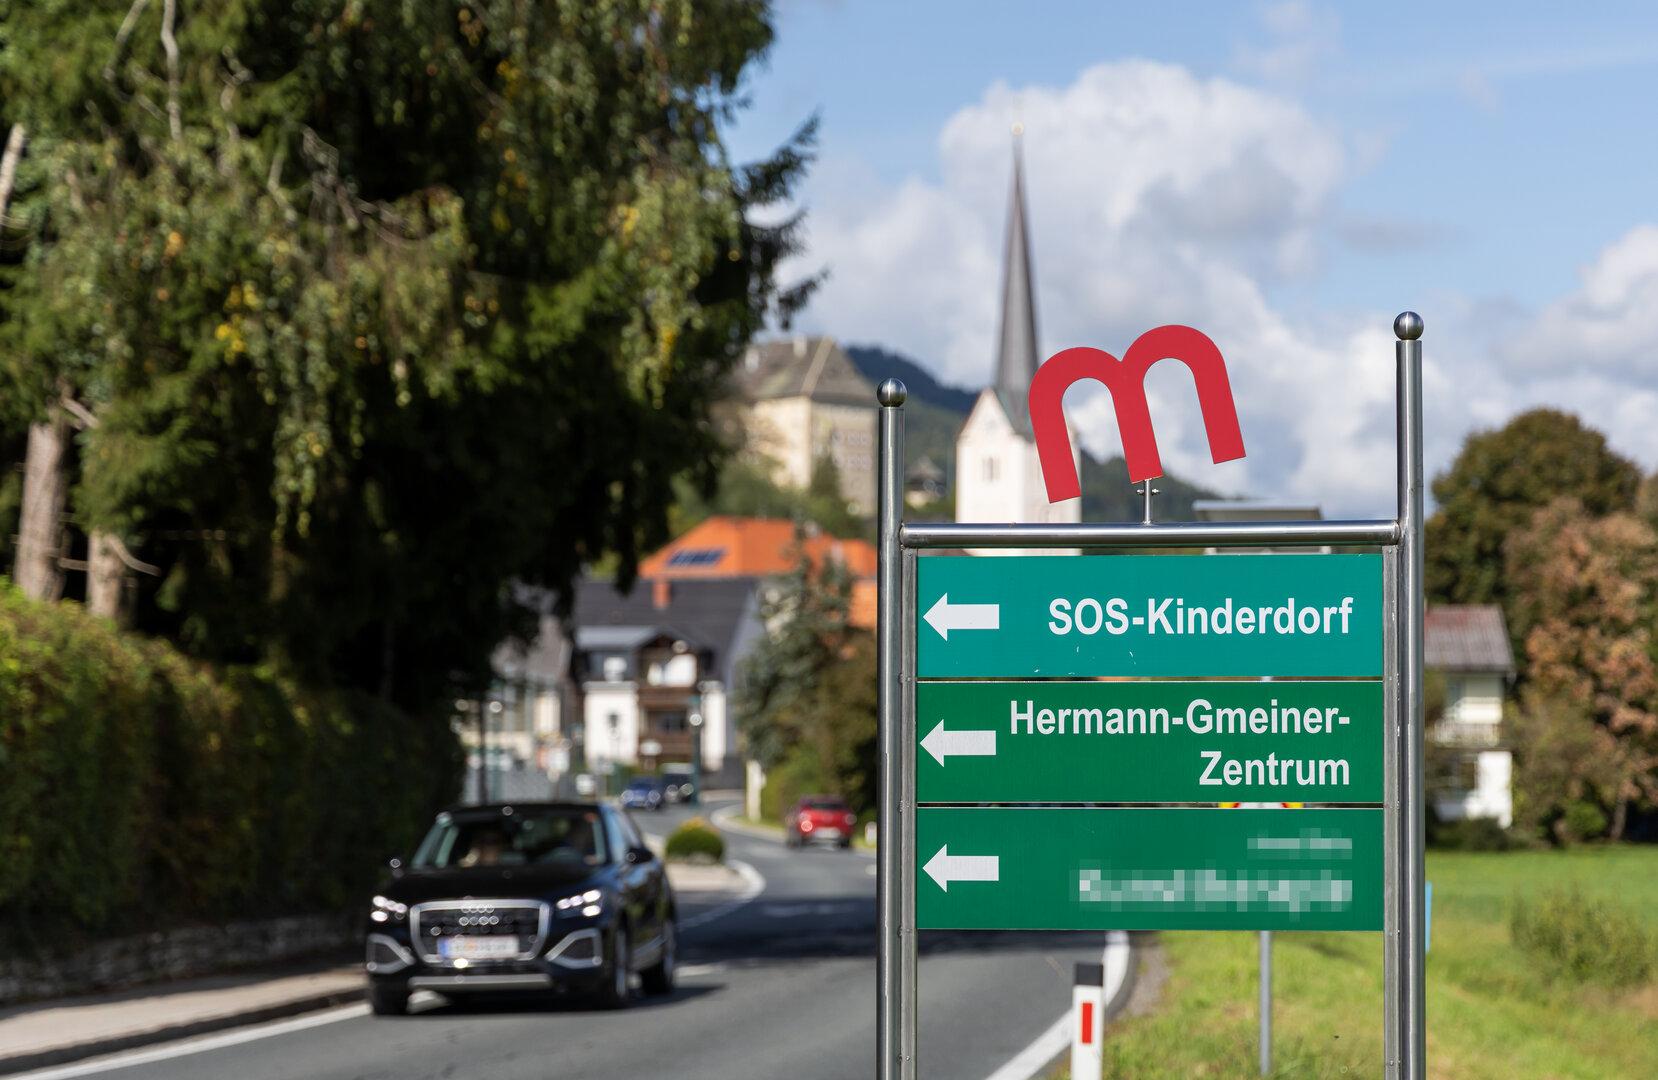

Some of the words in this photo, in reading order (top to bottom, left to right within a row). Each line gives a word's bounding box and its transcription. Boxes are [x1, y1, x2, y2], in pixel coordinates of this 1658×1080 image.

[1048, 597, 1353, 636] SOS-Kinderdorf
[1010, 699, 1351, 735] Hermann-Gmeiner-
[1199, 751, 1350, 786] Zentrum
